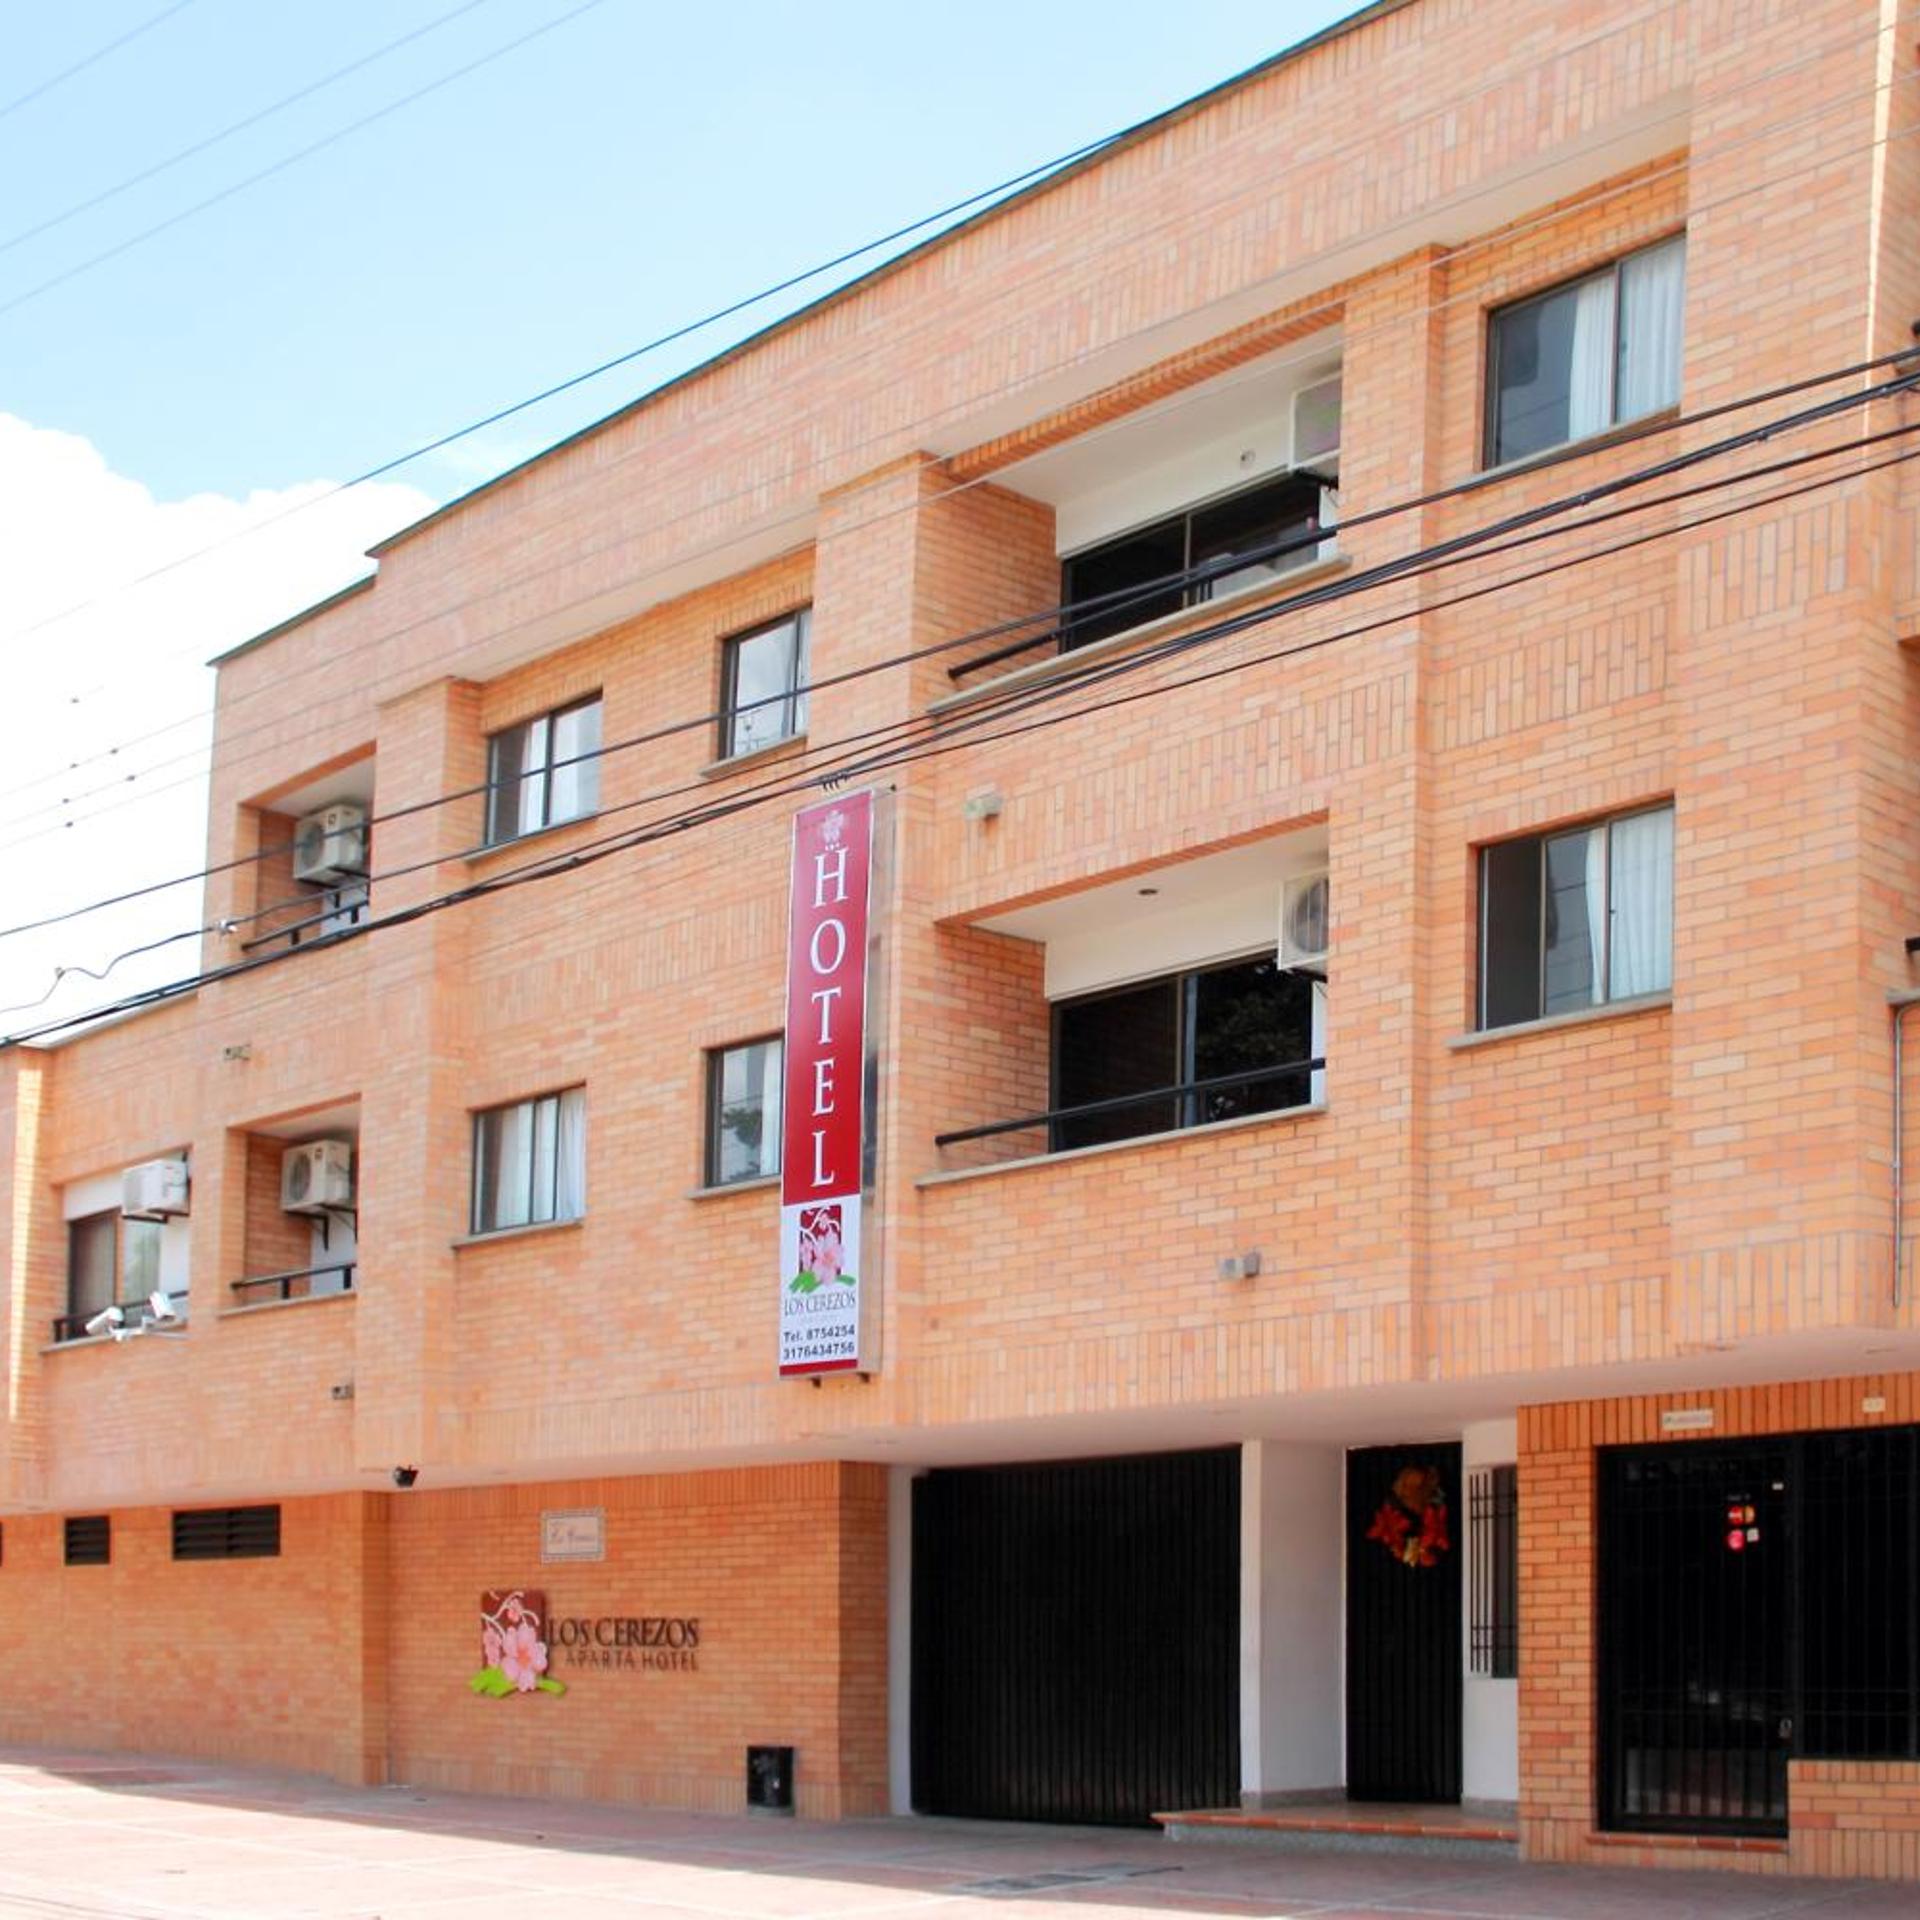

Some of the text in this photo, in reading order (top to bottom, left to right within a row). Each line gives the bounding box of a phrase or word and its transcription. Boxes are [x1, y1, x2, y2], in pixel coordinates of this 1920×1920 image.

[810, 847, 849, 1188] HOTEL
[784, 1292, 856, 1316] LOS CEREZOS
[784, 1331, 803, 1342] Tel.
[549, 1618, 699, 1648] LOS CEREZOS
[566, 1651, 699, 1671] APARTA HOTEL
